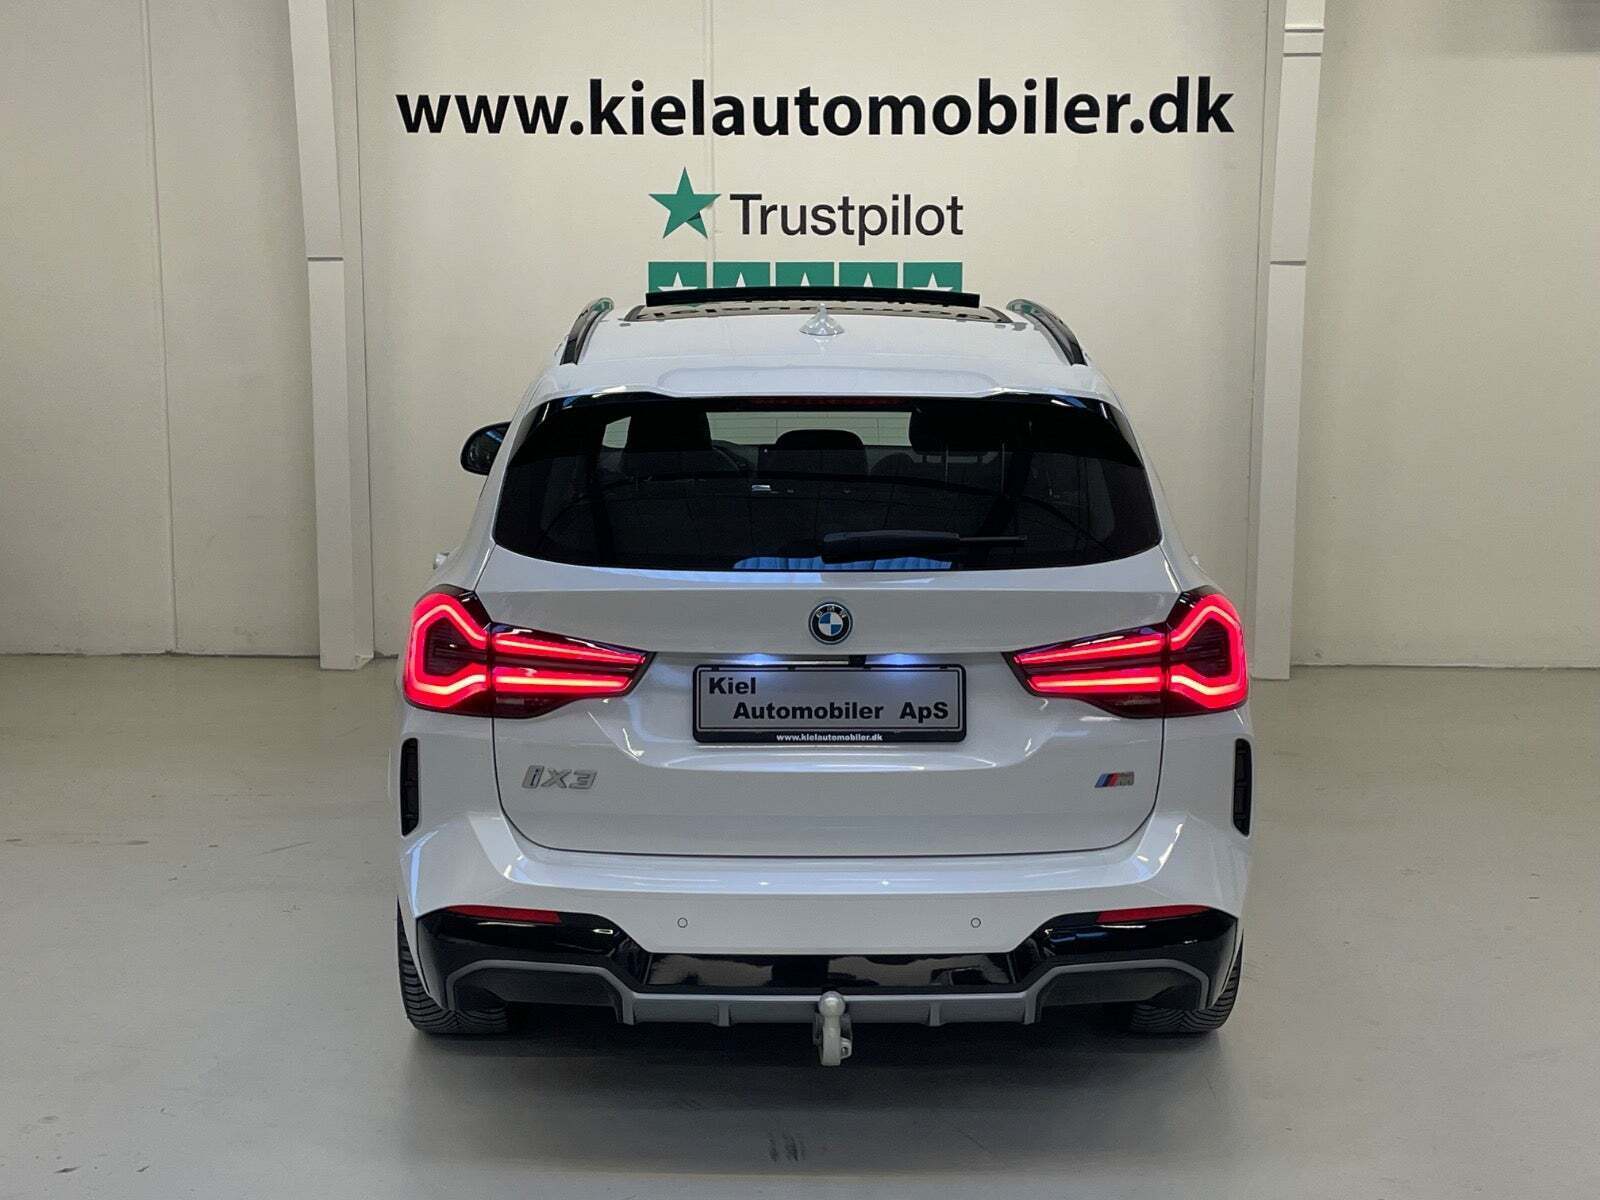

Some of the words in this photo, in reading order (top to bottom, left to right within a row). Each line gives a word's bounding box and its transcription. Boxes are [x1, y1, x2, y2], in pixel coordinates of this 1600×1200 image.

[396, 76, 1235, 136] www.kielautomobiler.dk
[730, 193, 964, 246] Trustpilot
[708, 676, 757, 695] Kiel
[733, 701, 884, 720] Automobiler
[899, 702, 949, 723] ApS
[775, 731, 884, 742] www.kielautomobiler.dk
